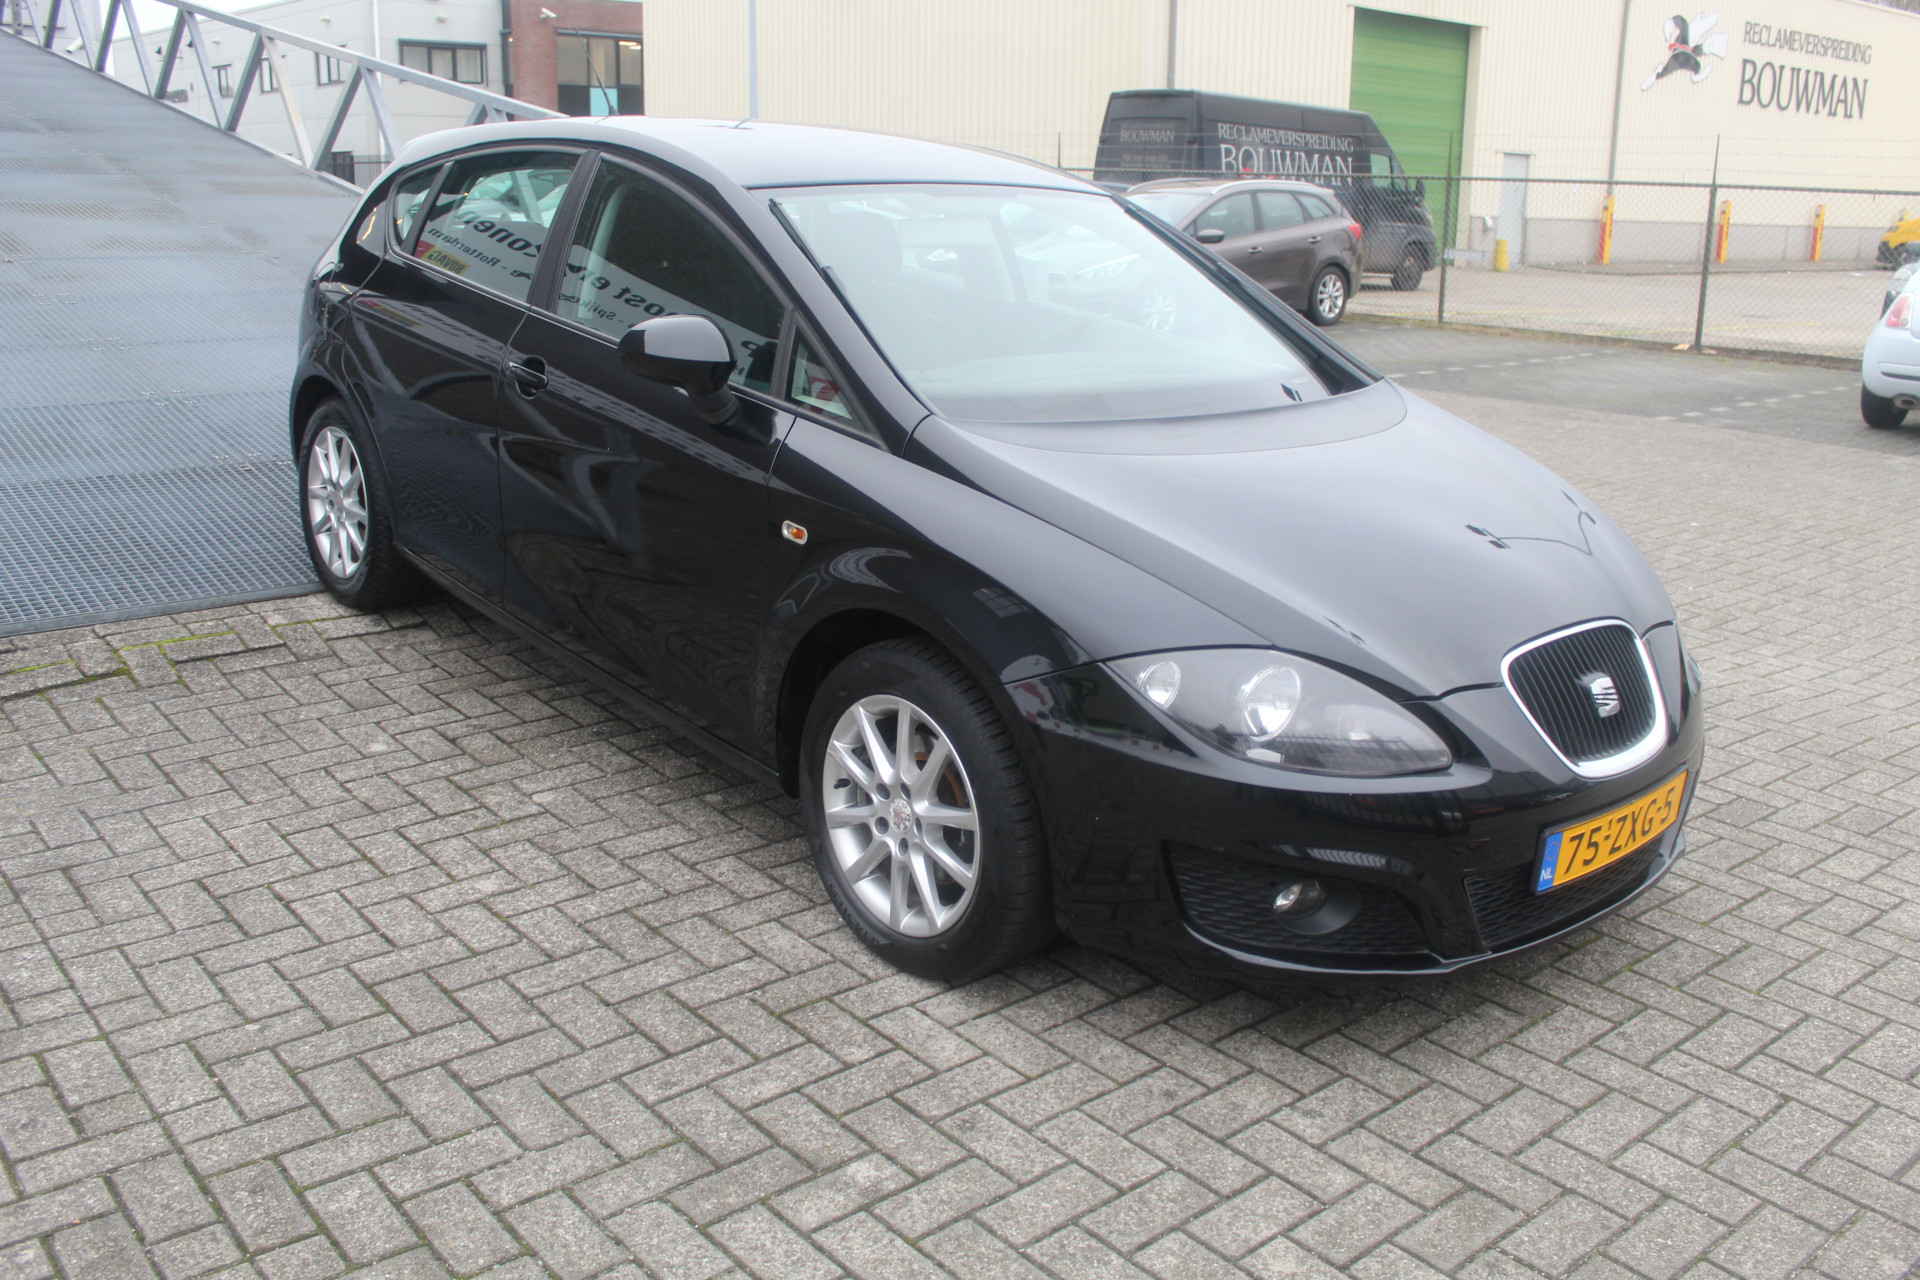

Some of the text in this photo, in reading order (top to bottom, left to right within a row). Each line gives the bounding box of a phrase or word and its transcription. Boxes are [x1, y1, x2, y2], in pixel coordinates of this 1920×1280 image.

[1743, 21, 1872, 64] RECLAMEVERSPREIDING
[1737, 58, 1868, 120] BOUWMAN
[1120, 129, 1175, 143] BOUWMAN
[1218, 122, 1354, 153] RECLAMEVERSPREIDING
[1219, 143, 1353, 187] BOUWMAN
[1564, 786, 1676, 875] 75-ZXG-5
[1540, 867, 1553, 882] NL
